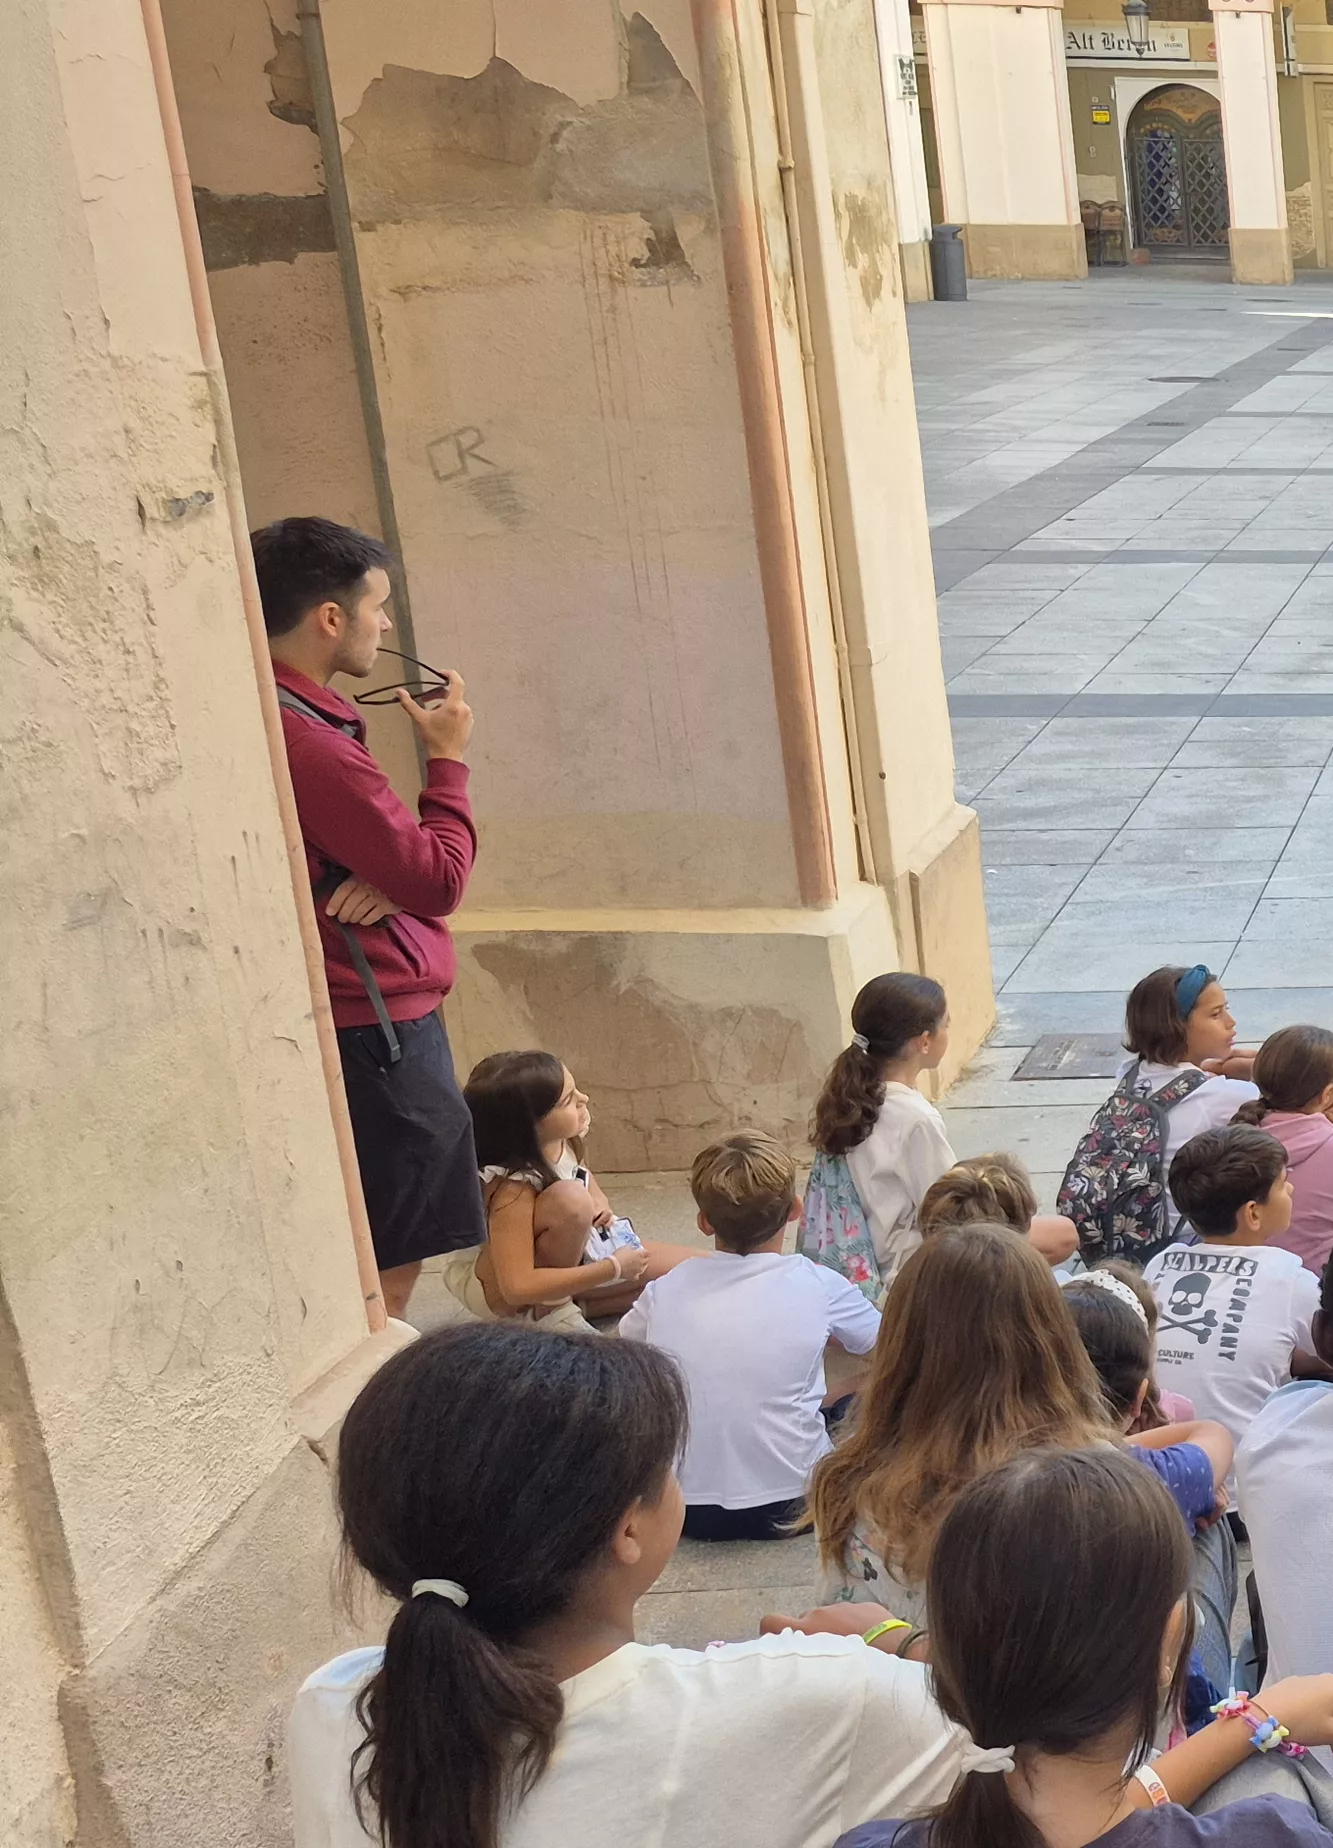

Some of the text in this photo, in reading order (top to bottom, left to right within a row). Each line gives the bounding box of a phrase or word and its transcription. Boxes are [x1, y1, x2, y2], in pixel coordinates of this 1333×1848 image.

[1066, 32, 1094, 51] Alt
[1102, 32, 1157, 52] Bern
[1164, 1252, 1257, 1277] SCALPERS
[1217, 1277, 1253, 1362] COMPANY
[1157, 1349, 1195, 1360] CULTURE
